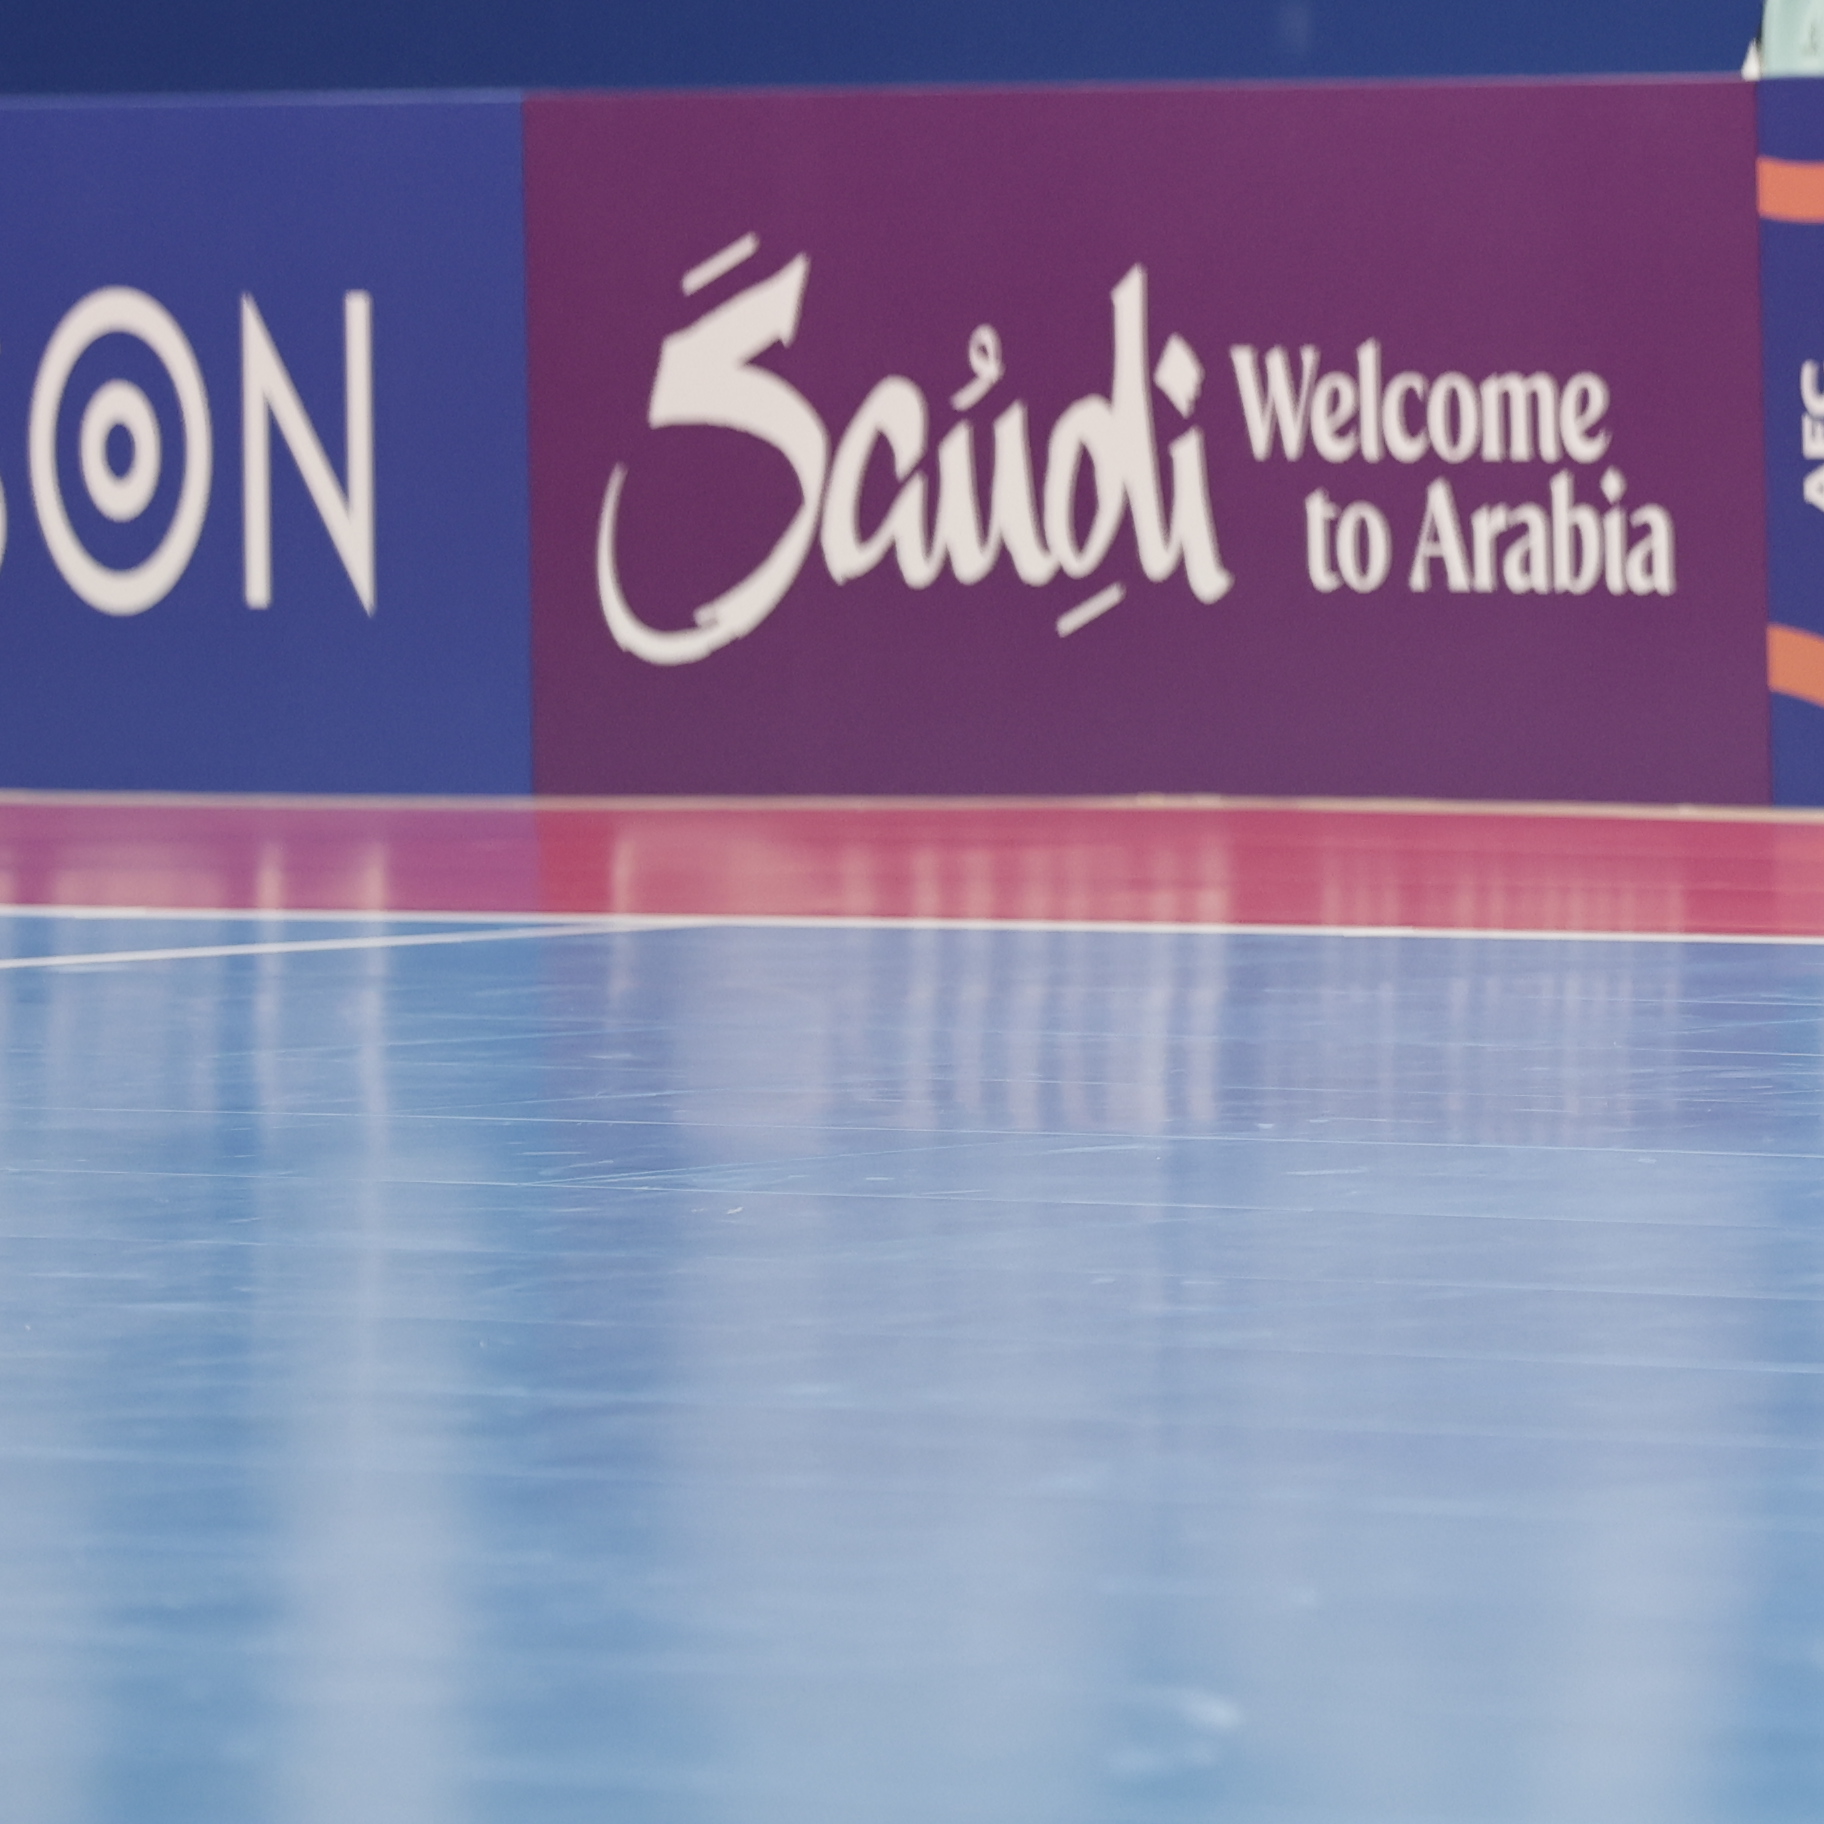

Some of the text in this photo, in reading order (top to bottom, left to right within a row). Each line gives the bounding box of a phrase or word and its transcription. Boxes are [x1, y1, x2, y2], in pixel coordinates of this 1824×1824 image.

[0, 284, 377, 617] ON
[596, 233, 1232, 665] Saudi
[1231, 339, 1609, 464] Welcome
[1305, 465, 1676, 595] to Arabia
